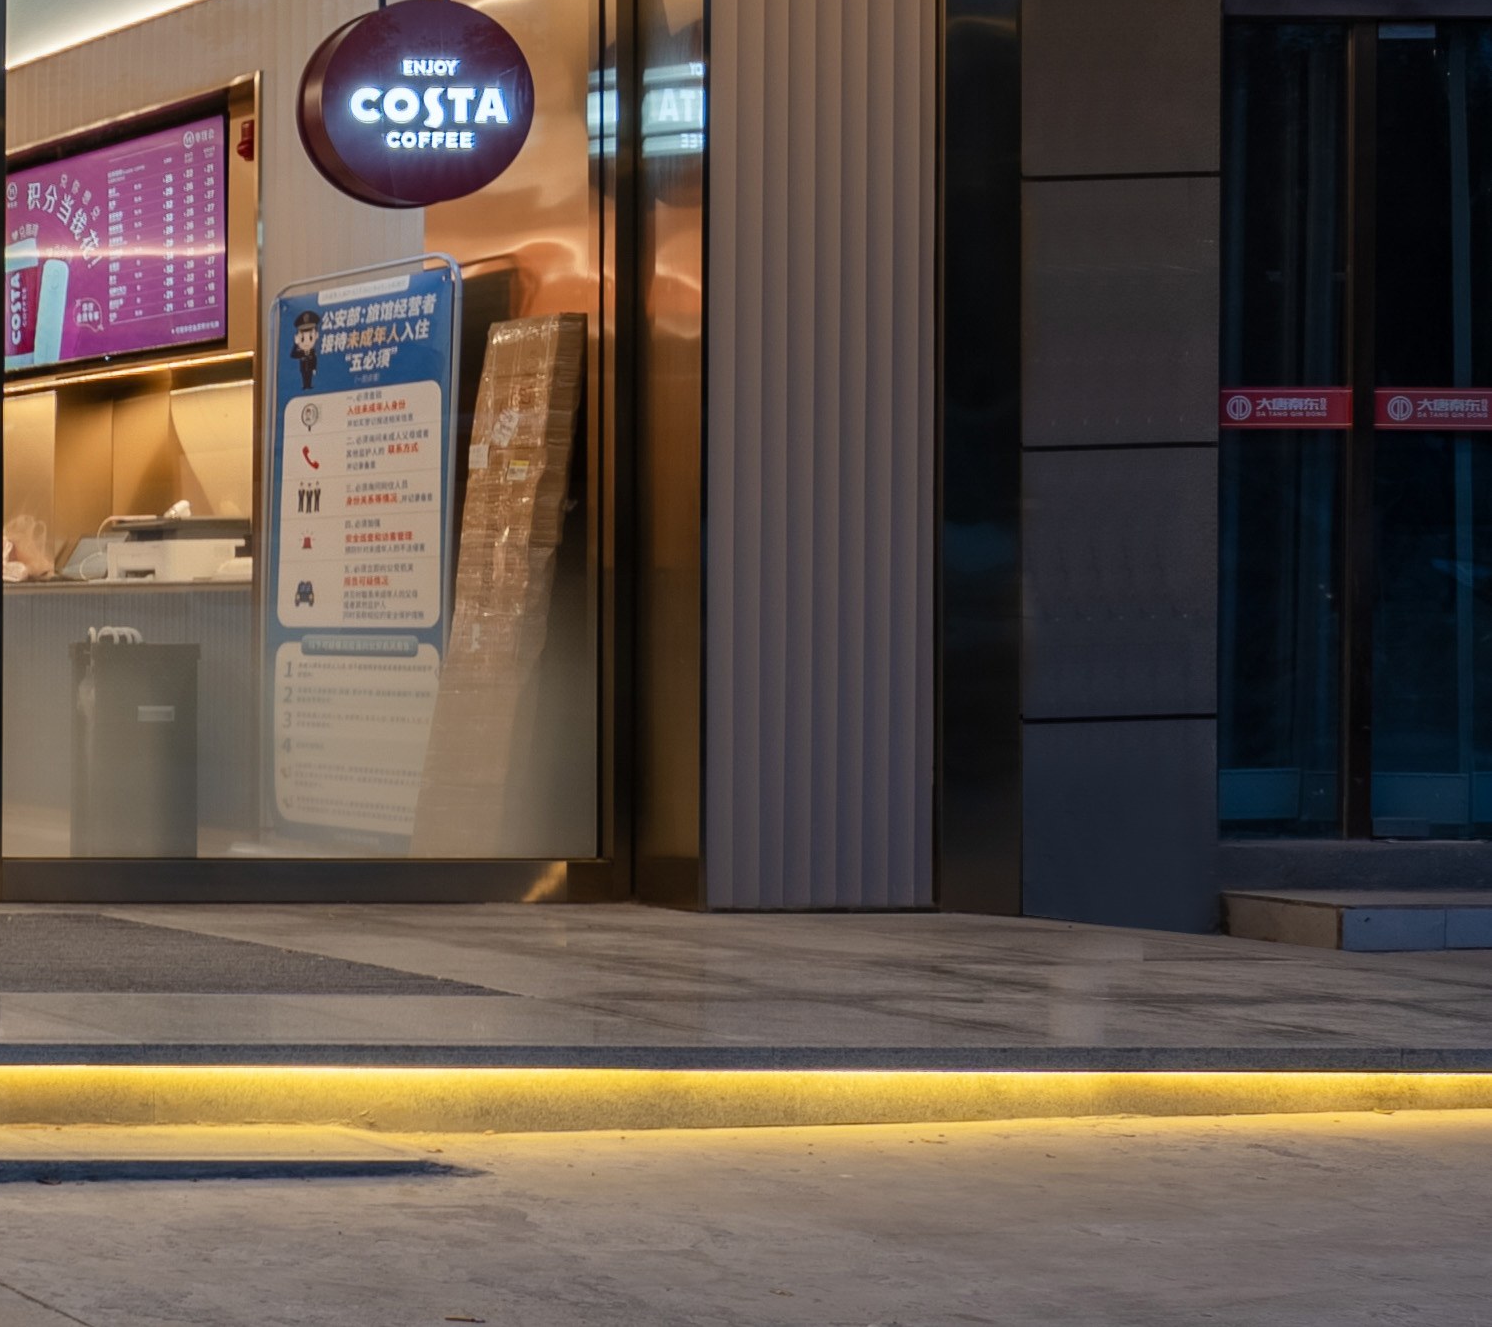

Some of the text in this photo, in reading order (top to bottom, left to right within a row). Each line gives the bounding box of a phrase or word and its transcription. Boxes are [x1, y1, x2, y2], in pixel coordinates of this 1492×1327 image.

[402, 58, 460, 76] ENJOY
[349, 86, 510, 128] COSTA
[386, 131, 475, 149] COFFEE
[10, 272, 21, 345] COSTA
